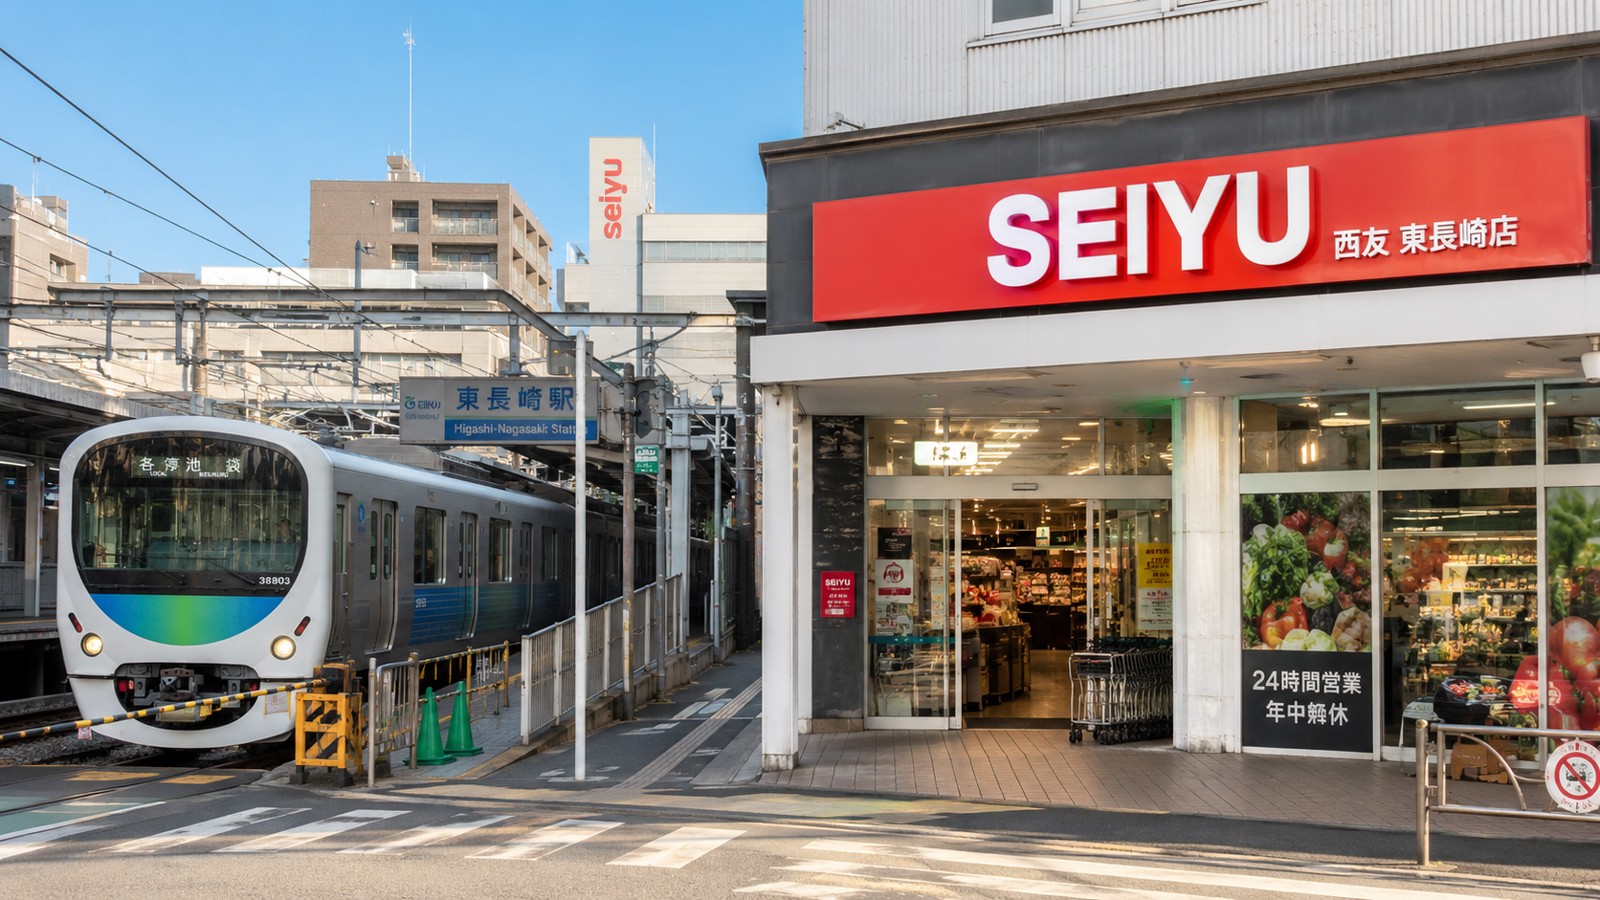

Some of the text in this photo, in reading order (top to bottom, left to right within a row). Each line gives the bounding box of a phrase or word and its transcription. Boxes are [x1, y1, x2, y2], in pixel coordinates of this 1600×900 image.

[598, 158, 628, 240] seiyu
[986, 164, 1311, 288] SEIYU
[1333, 214, 1519, 261] 西友 東長崎店
[456, 385, 575, 412] 東長崎駅
[258, 576, 291, 585] 38803
[1252, 669, 1362, 695] 24時間営業
